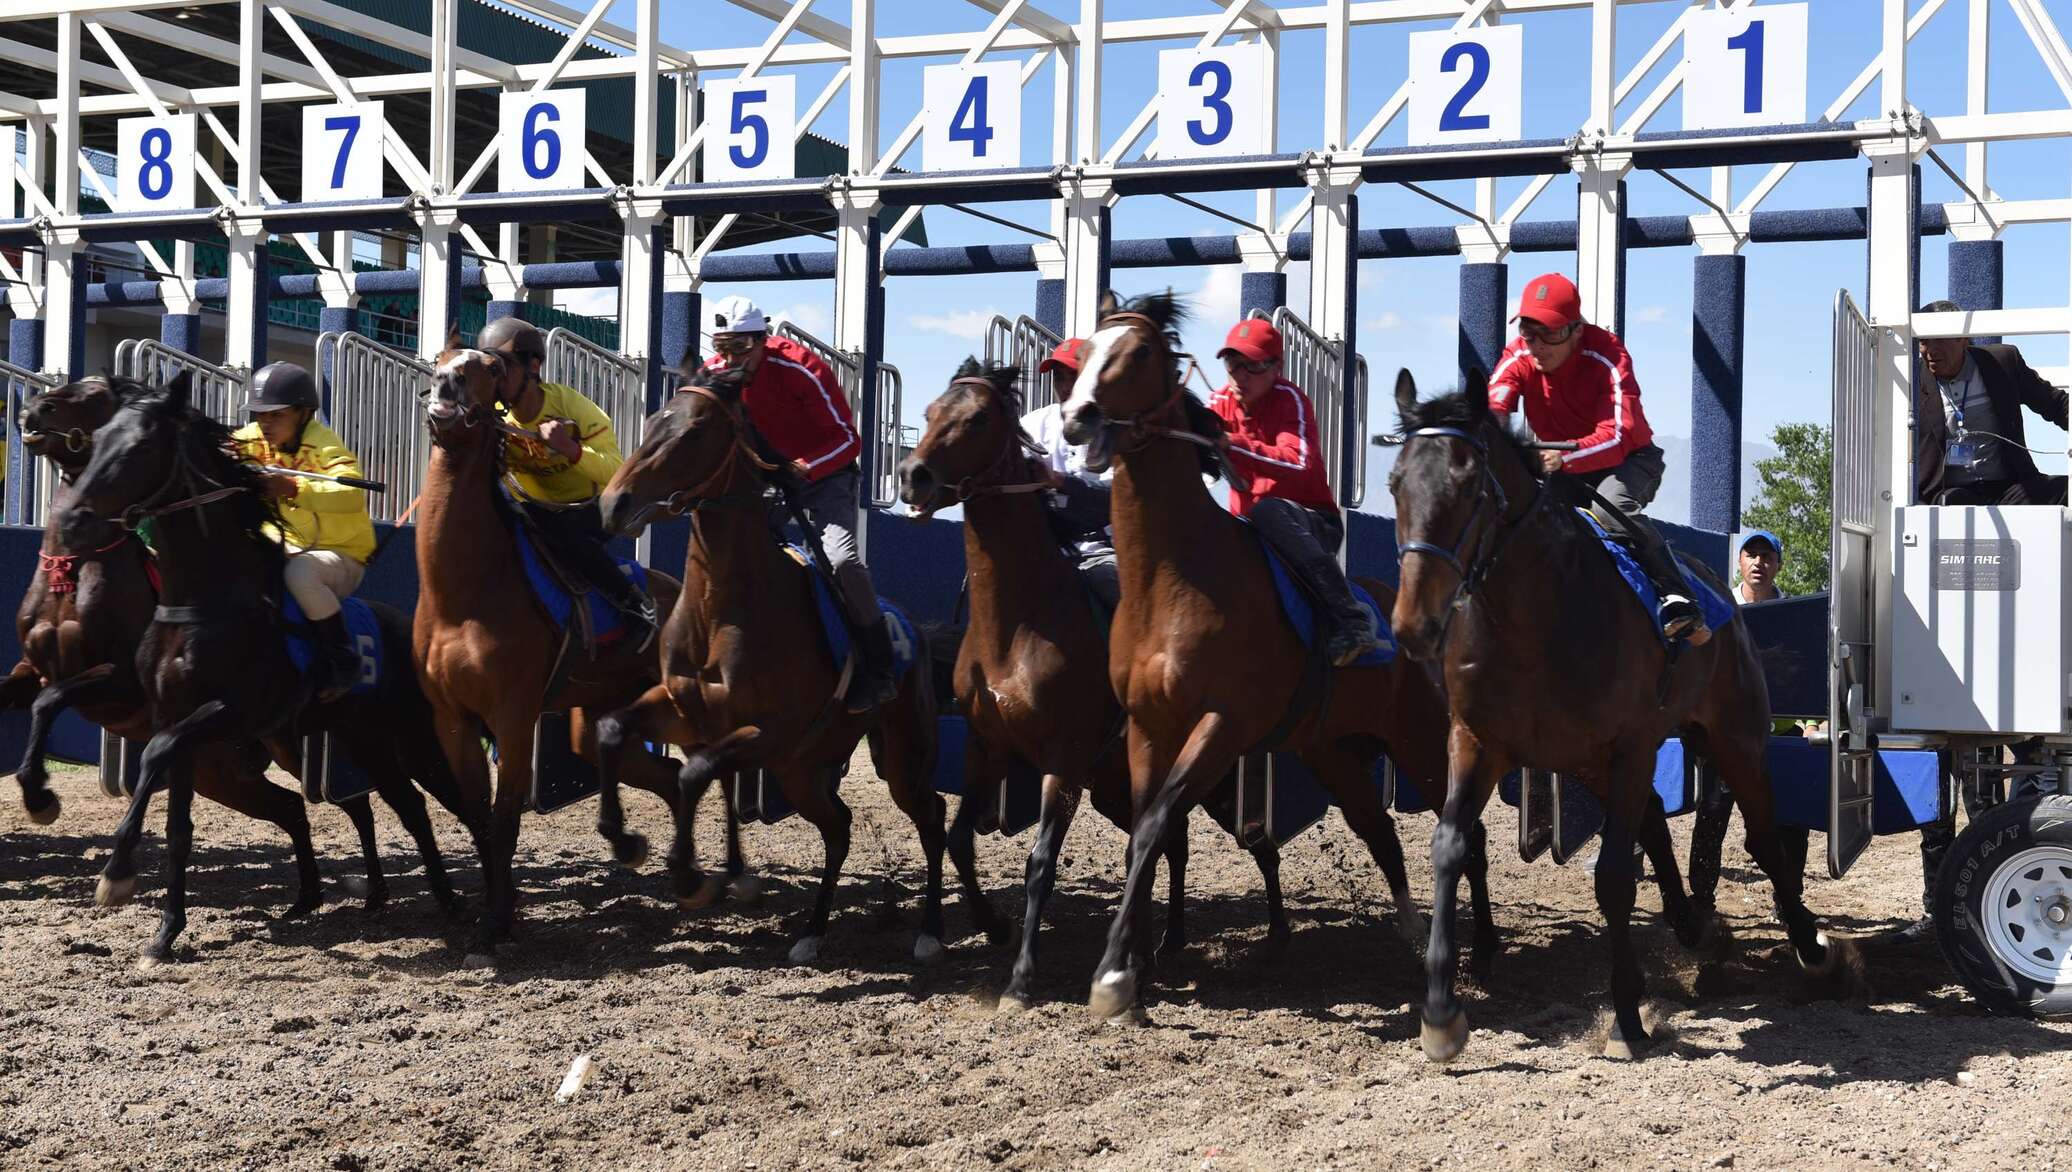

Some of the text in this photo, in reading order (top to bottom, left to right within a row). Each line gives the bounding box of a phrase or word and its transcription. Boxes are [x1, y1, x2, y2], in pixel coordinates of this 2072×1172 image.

[1187, 60, 1233, 145] 3
[1439, 42, 1490, 131] 2
[1728, 20, 1764, 113] 1
[325, 116, 361, 189] 7
[522, 102, 561, 180] 6
[729, 90, 769, 168] 5
[949, 76, 993, 157] 4
[138, 128, 173, 200] 8
[1940, 555, 2008, 565] SIMRAC
